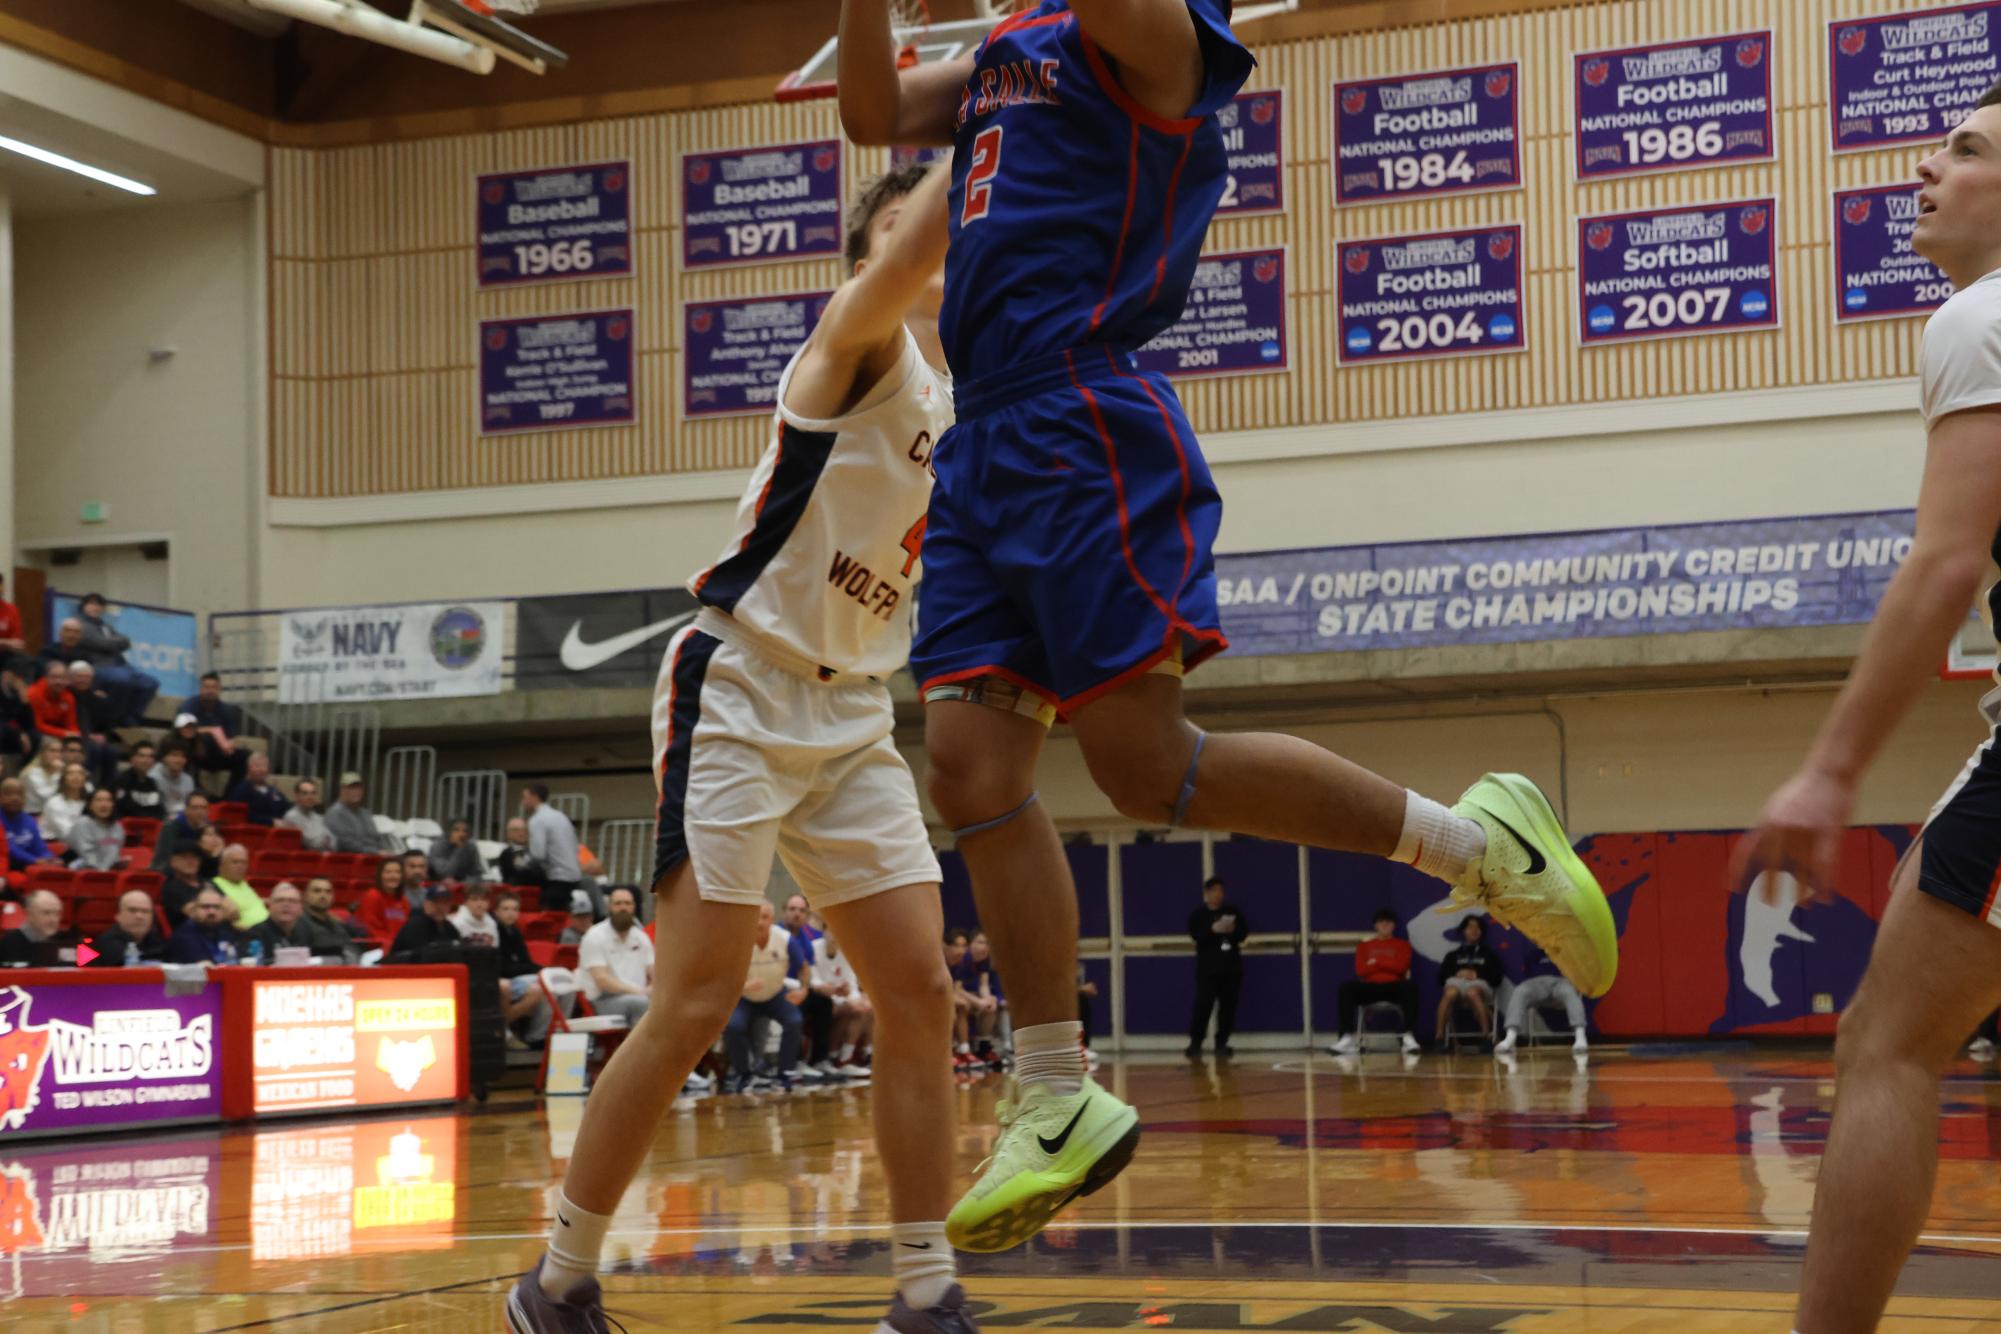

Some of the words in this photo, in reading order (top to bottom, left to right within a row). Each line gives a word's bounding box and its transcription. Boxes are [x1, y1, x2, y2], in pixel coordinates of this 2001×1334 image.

[1882, 12, 1987, 48] WILDCATS
[1623, 47, 1721, 81] WILDCATS
[1880, 48, 1925, 66] Track
[1930, 46, 1942, 60] &
[1948, 38, 1989, 57] Field
[1874, 68, 1910, 85] Curt
[1915, 55, 1997, 80] Heywood
[1617, 72, 1728, 108] Football
[1841, 95, 1930, 119] NATIONAL
[1849, 87, 1889, 102] Indoor
[1904, 79, 1955, 95] Outdoor
[1374, 102, 1478, 136] Football
[1581, 109, 1663, 132] NATIONAL
[1666, 97, 1767, 122] CHAMPIONS
[1883, 114, 1929, 135] 1993
[1941, 107, 1976, 128] 199
[1340, 138, 1416, 159] NATIONAL
[1419, 126, 1514, 150] CHAMPIONS
[1622, 121, 1723, 164] 1986
[961, 124, 1003, 228] 2
[1378, 150, 1475, 191] 1984
[714, 175, 809, 205] Baseball
[508, 196, 599, 224] Baseball
[725, 220, 797, 256] 1971
[1627, 213, 1725, 246] WILDCATS
[514, 239, 593, 274] 1966
[1623, 238, 1729, 272] Softball
[1377, 263, 1481, 296] Football
[1585, 274, 1666, 296] NATIONAL
[1670, 264, 1771, 287] CHAMPIONS
[1846, 266, 1934, 288] NATIONAL
[1343, 298, 1420, 319] NATIONAL
[1422, 288, 1518, 311] CHAMPIONS
[1622, 287, 1731, 330] 2007
[1196, 327, 1277, 346] CHAMPION
[1376, 311, 1484, 352] 2004
[1178, 349, 1218, 367] 2001
[1217, 576, 1279, 607] SAA
[1310, 564, 1460, 600] ONPOINT
[1466, 550, 1680, 591] COMMUNITY
[1684, 542, 1821, 577] CREDIT
[1826, 536, 1915, 568] UNIO
[1317, 600, 1438, 637] STATE
[1444, 578, 1799, 630] CHAMPIONSHIPS
[332, 621, 402, 656] NAVY
[53, 1021, 209, 1079] WILDCATS
